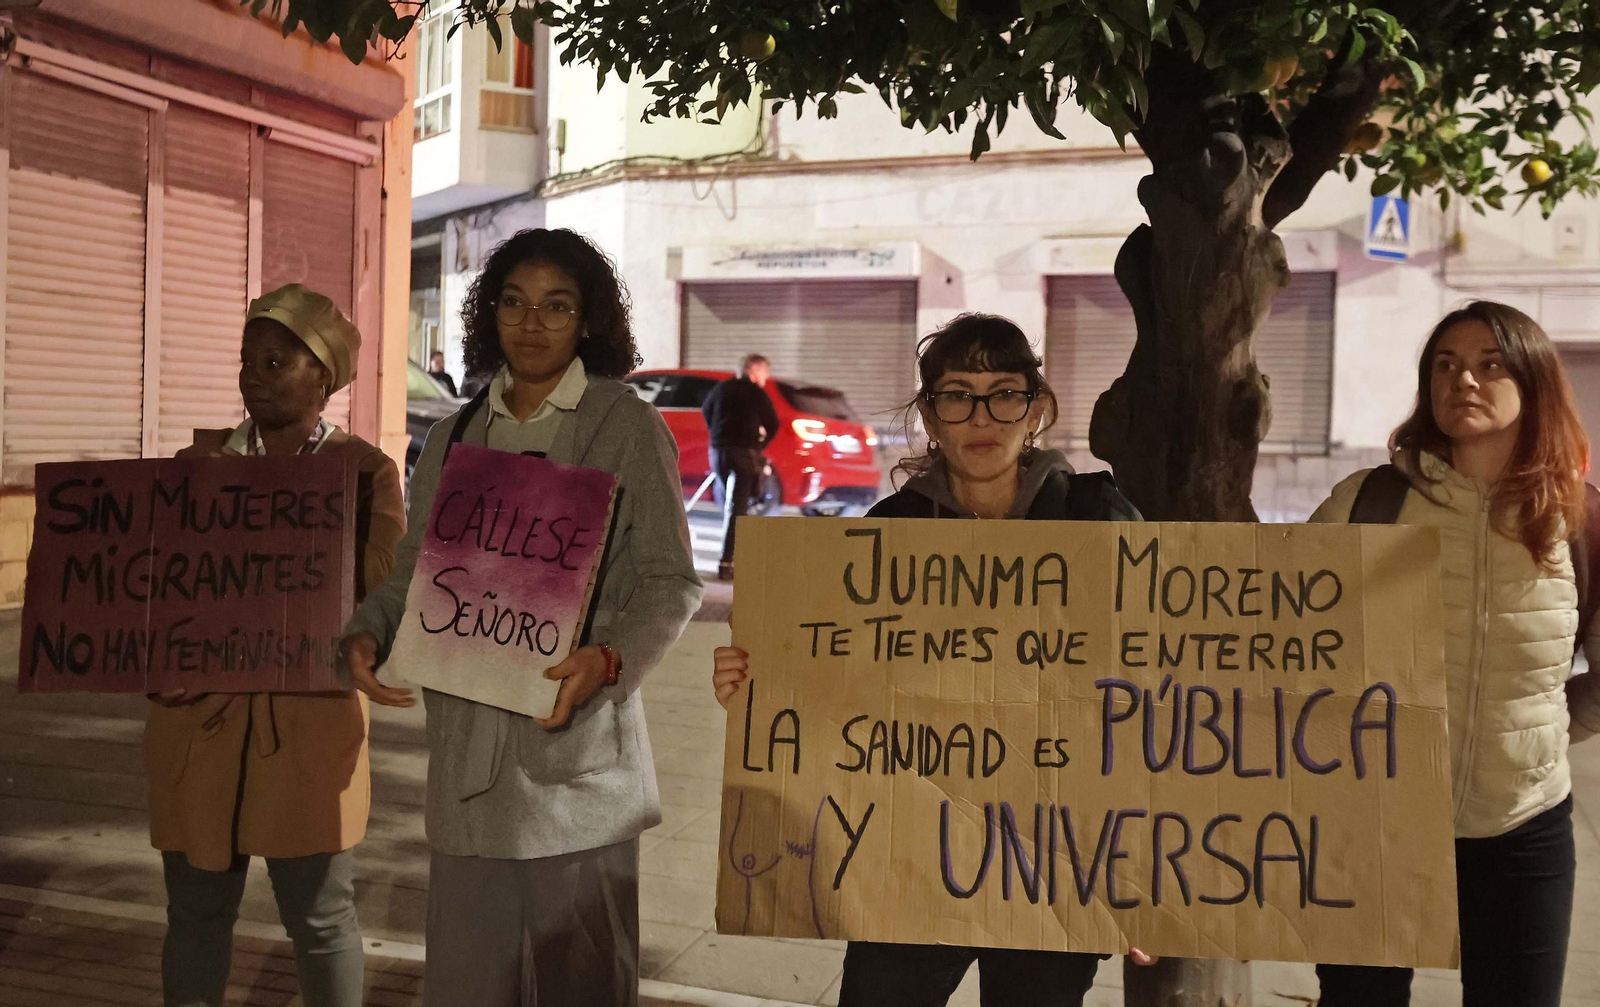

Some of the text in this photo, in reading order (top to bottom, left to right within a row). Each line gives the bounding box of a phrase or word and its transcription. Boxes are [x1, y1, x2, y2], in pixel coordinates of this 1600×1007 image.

[149, 475, 343, 534] MUJERES
[434, 485, 592, 571] CÁLLESE
[419, 566, 560, 656] SEÑORO
[843, 528, 1343, 620] JUANMA MORENO
[30, 621, 97, 678] NO
[103, 628, 156, 674] HAY
[800, 614, 1344, 672] TE TIENES QUE ENTERAR
[742, 673, 1397, 780] LA SANIDAD ES PÚBLICA
[826, 794, 1356, 909] Y UNIVERSAL
